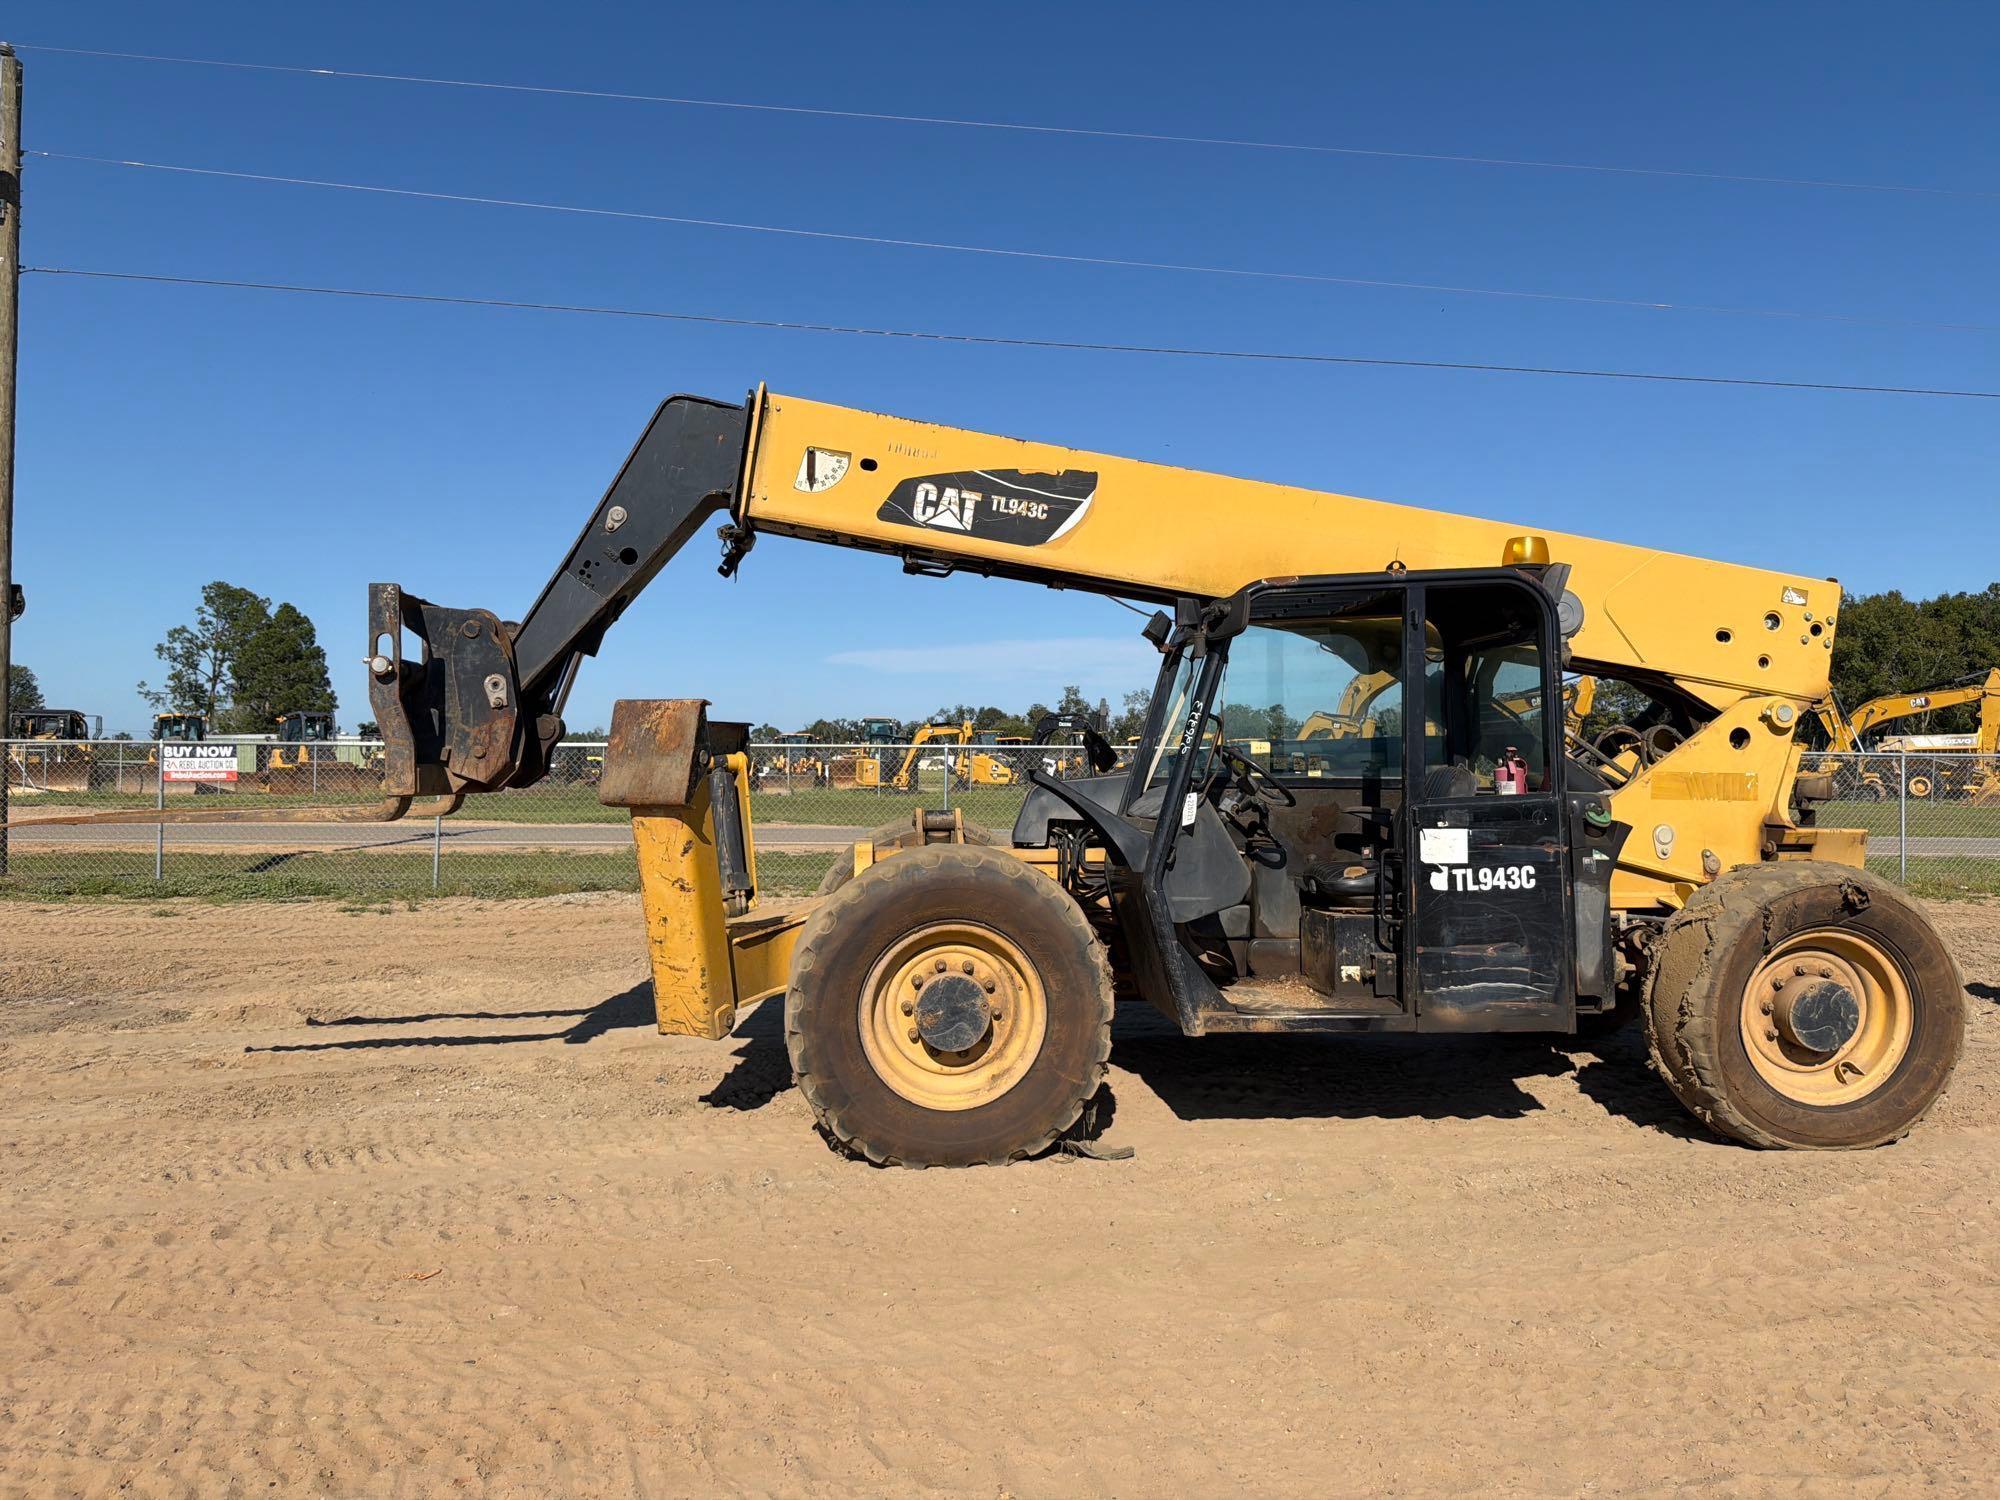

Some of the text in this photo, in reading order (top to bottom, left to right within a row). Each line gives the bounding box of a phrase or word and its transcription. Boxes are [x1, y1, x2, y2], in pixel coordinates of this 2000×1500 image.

[913, 482, 982, 531] CAT
[991, 494, 1049, 521] TL943C
[1531, 696, 1542, 707] CA
[1910, 697, 1926, 708] CAT
[1181, 700, 1203, 754] 226223
[164, 746, 233, 758] BUY NOW
[179, 760, 197, 769] REBEL
[198, 760, 224, 769] AUCTION
[1452, 865, 1536, 892] TL943C
